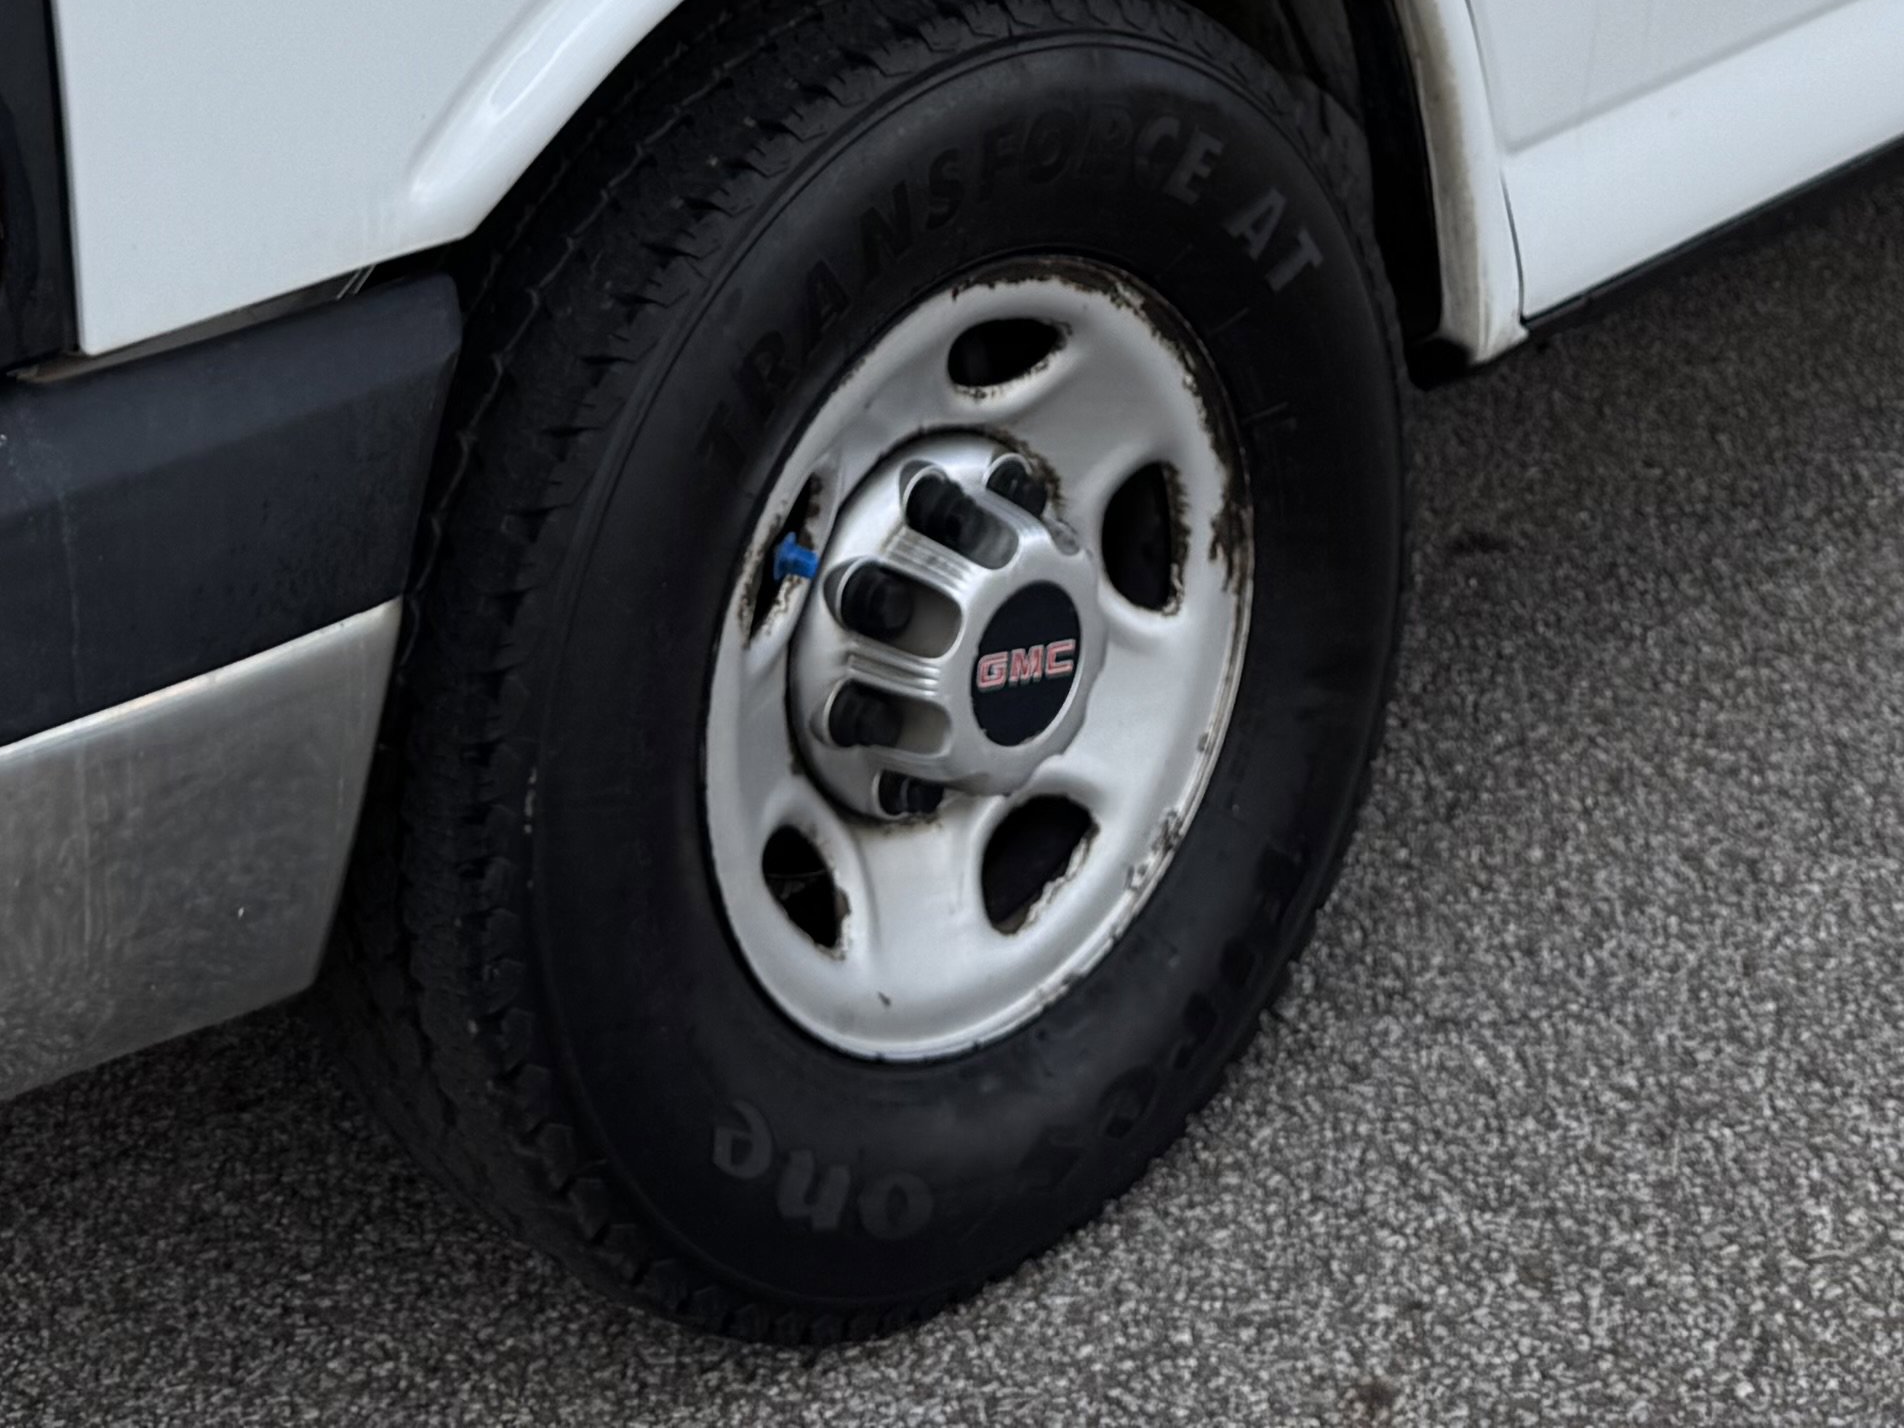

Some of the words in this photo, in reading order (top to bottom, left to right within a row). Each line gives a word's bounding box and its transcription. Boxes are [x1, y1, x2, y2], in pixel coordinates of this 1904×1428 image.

[694, 103, 1225, 472] TRANSFORCE
[1223, 187, 1325, 293] AT
[976, 638, 1077, 691] GMC
